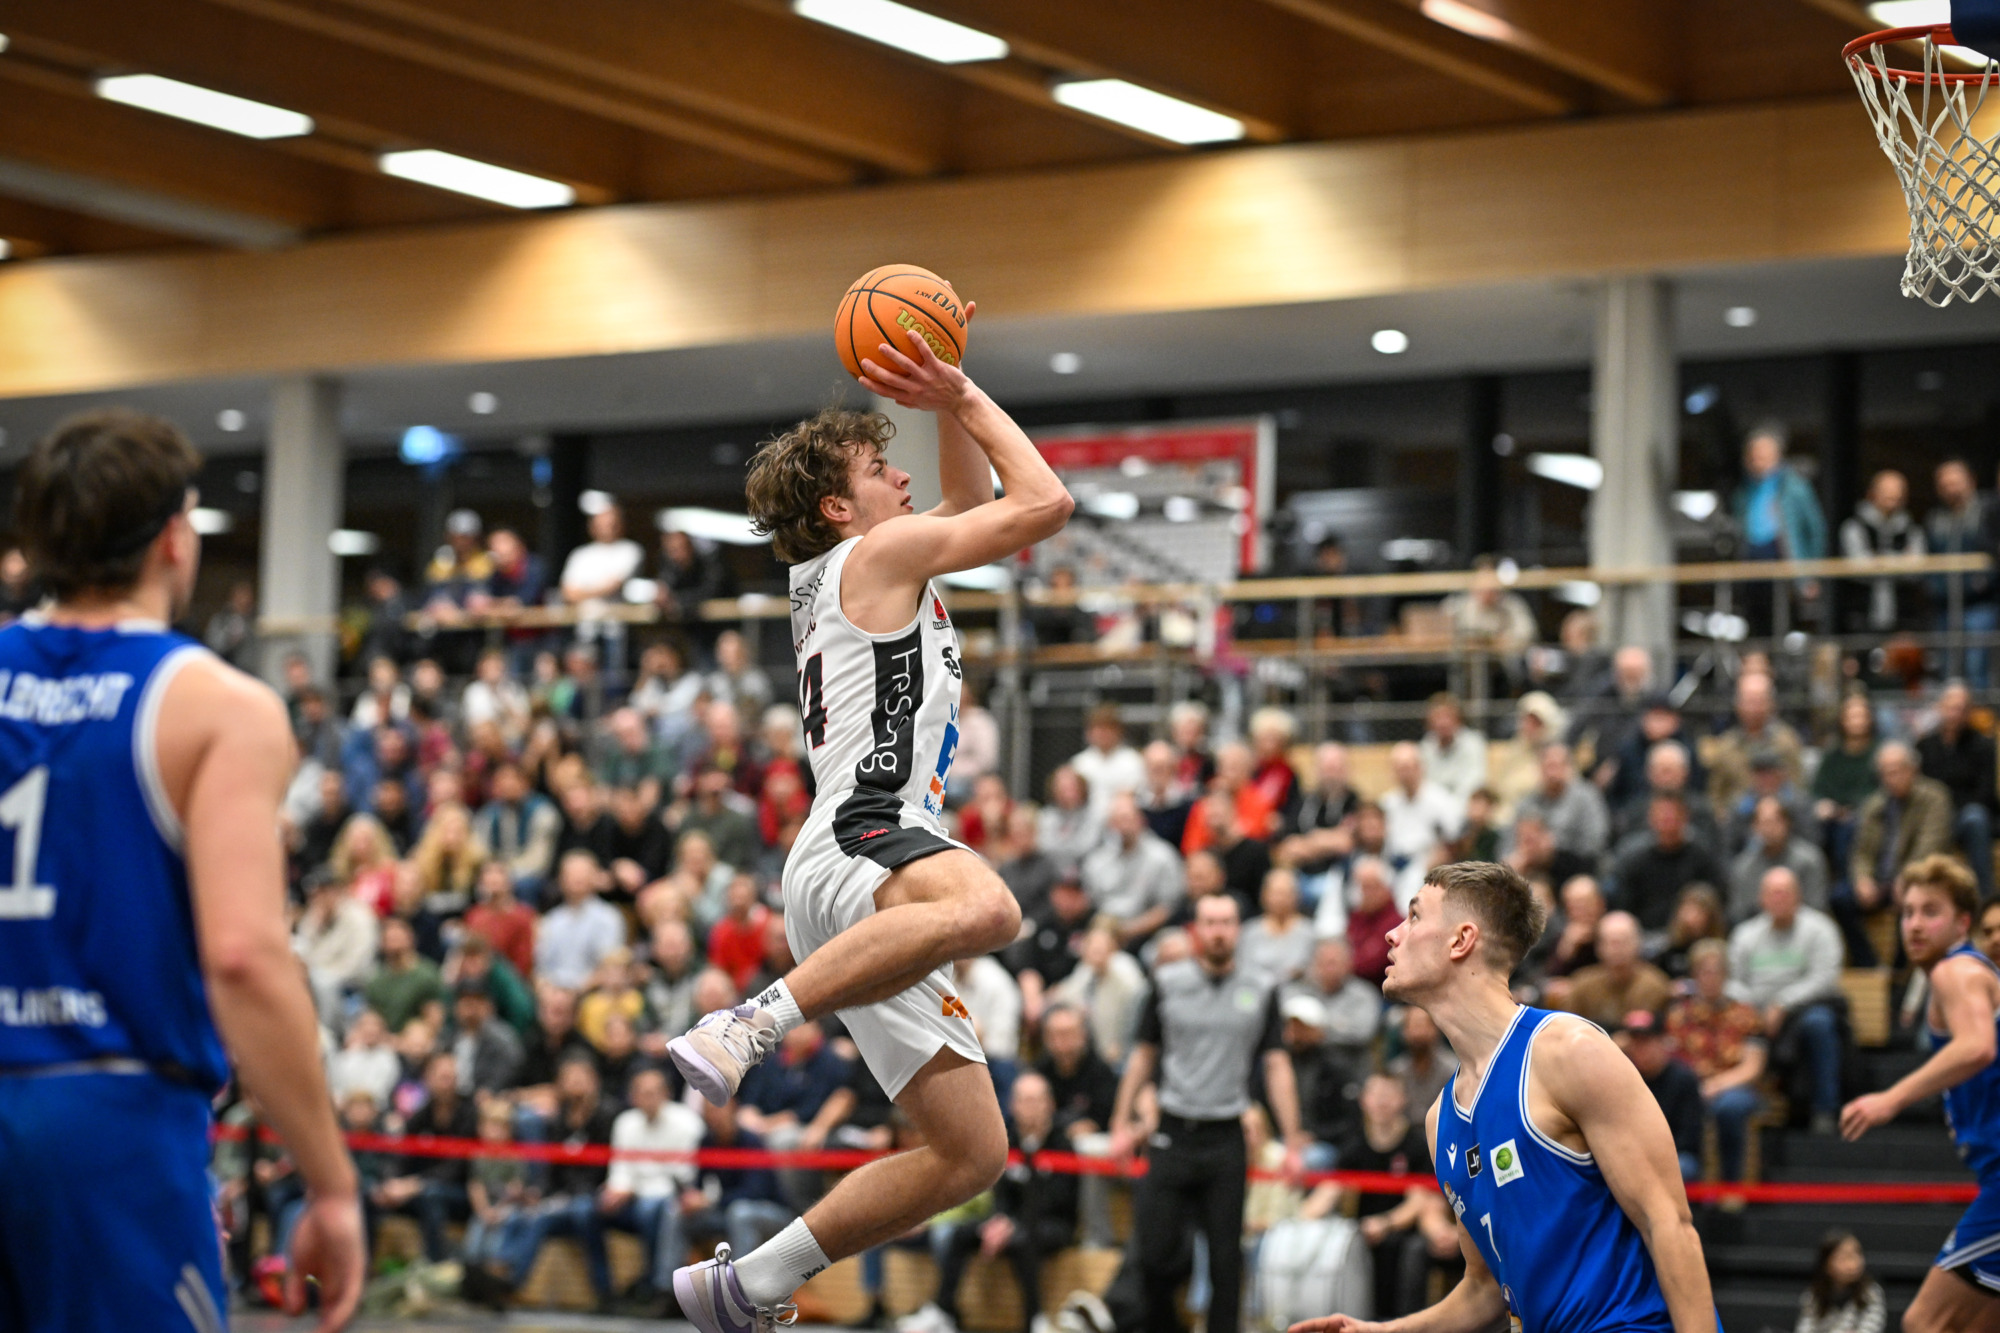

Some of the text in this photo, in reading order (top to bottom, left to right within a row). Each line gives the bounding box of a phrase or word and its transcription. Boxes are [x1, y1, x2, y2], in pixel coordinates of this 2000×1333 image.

[915, 290, 966, 328] EVO NXT
[798, 652, 828, 750] 4
